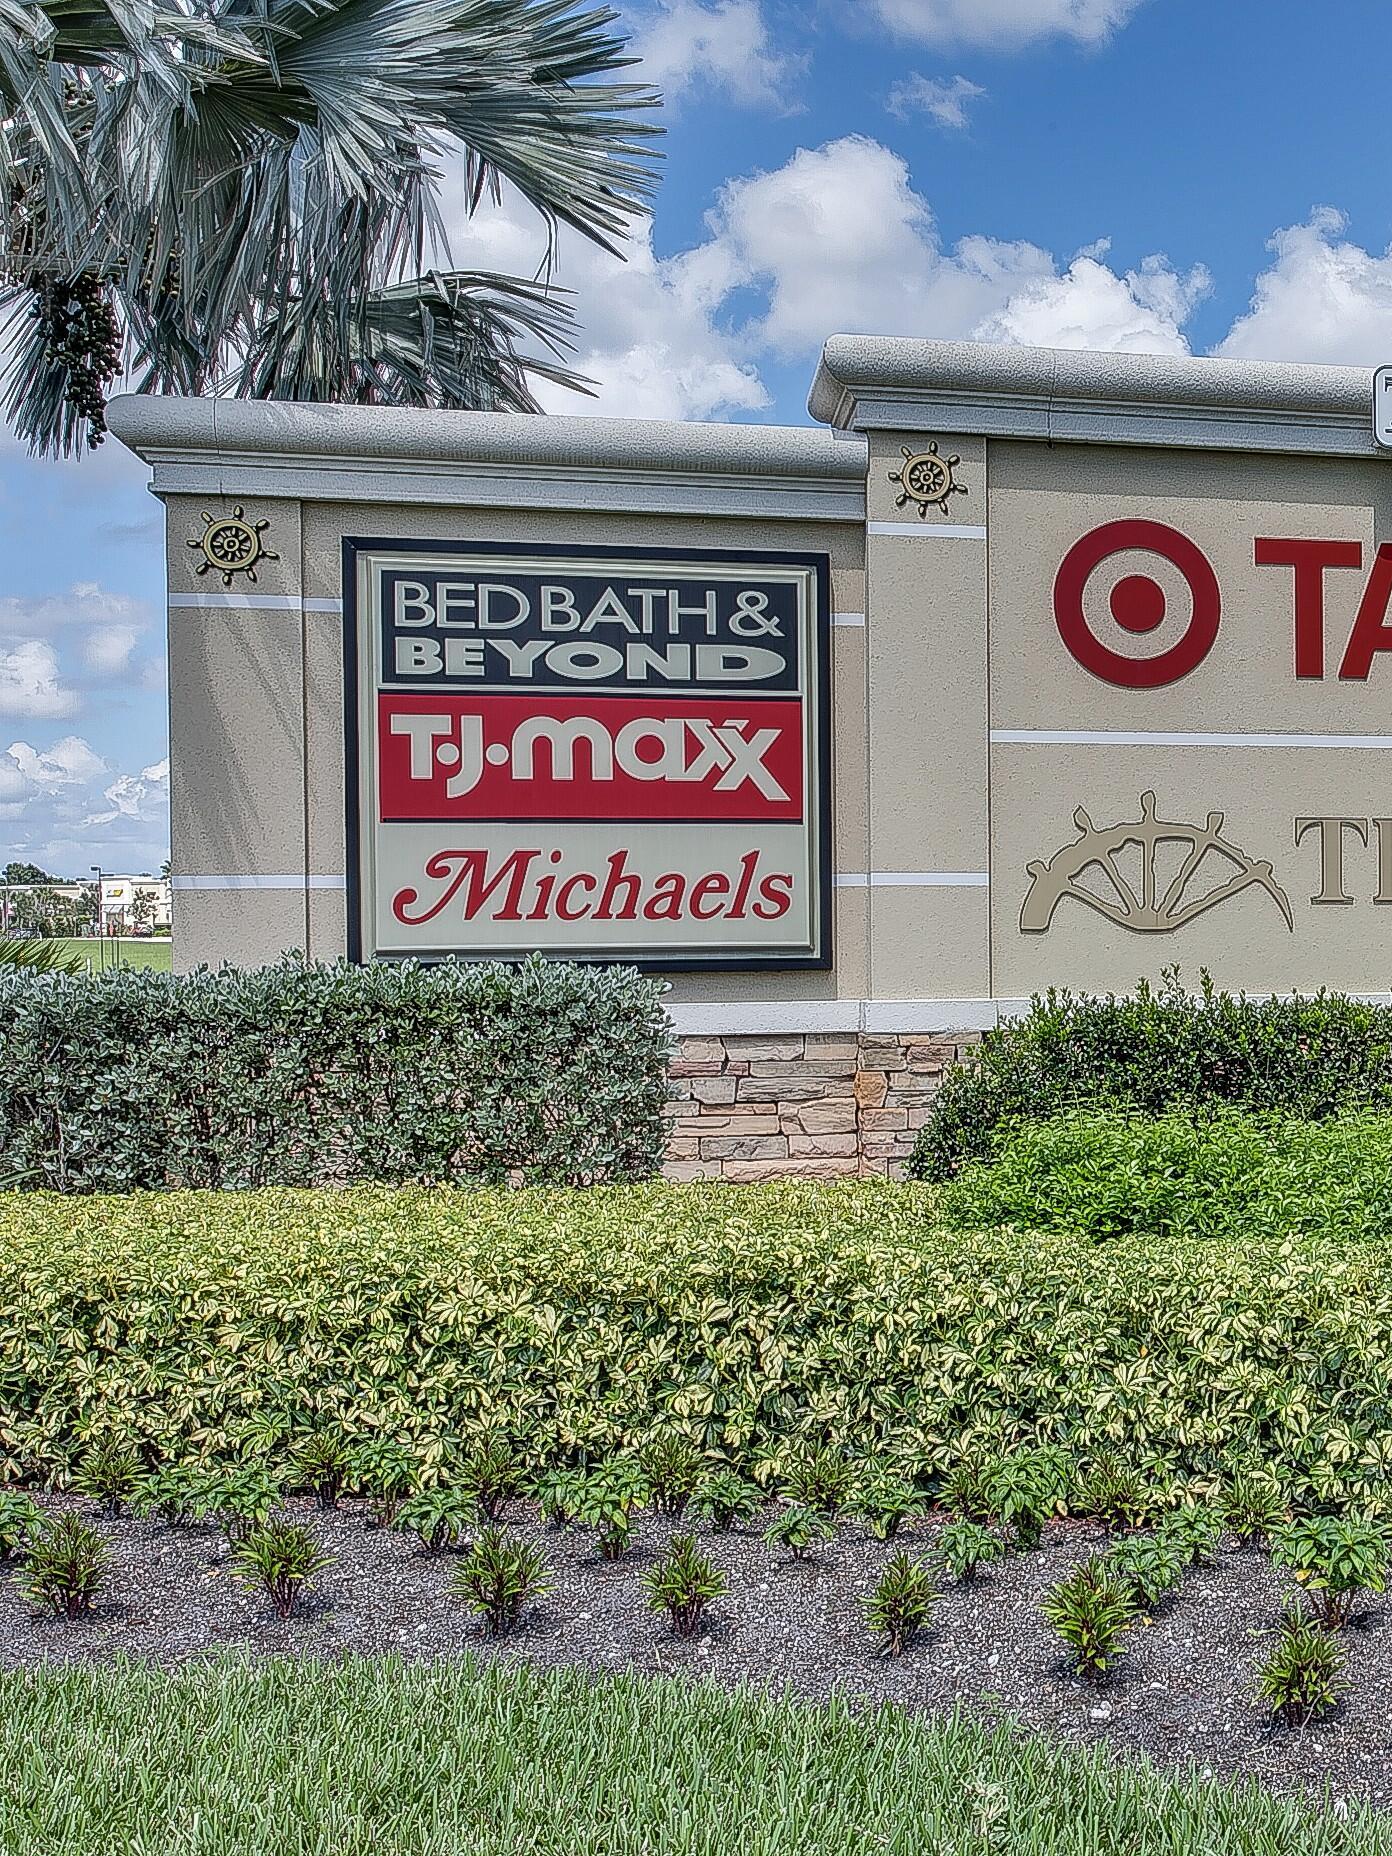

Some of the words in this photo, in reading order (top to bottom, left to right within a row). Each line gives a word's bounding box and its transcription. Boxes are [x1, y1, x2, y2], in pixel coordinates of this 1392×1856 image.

[394, 580, 531, 631] BED
[540, 586, 717, 637] BATH
[728, 590, 786, 638] &
[394, 637, 787, 682] BEYOND
[392, 848, 793, 925] Michaels
